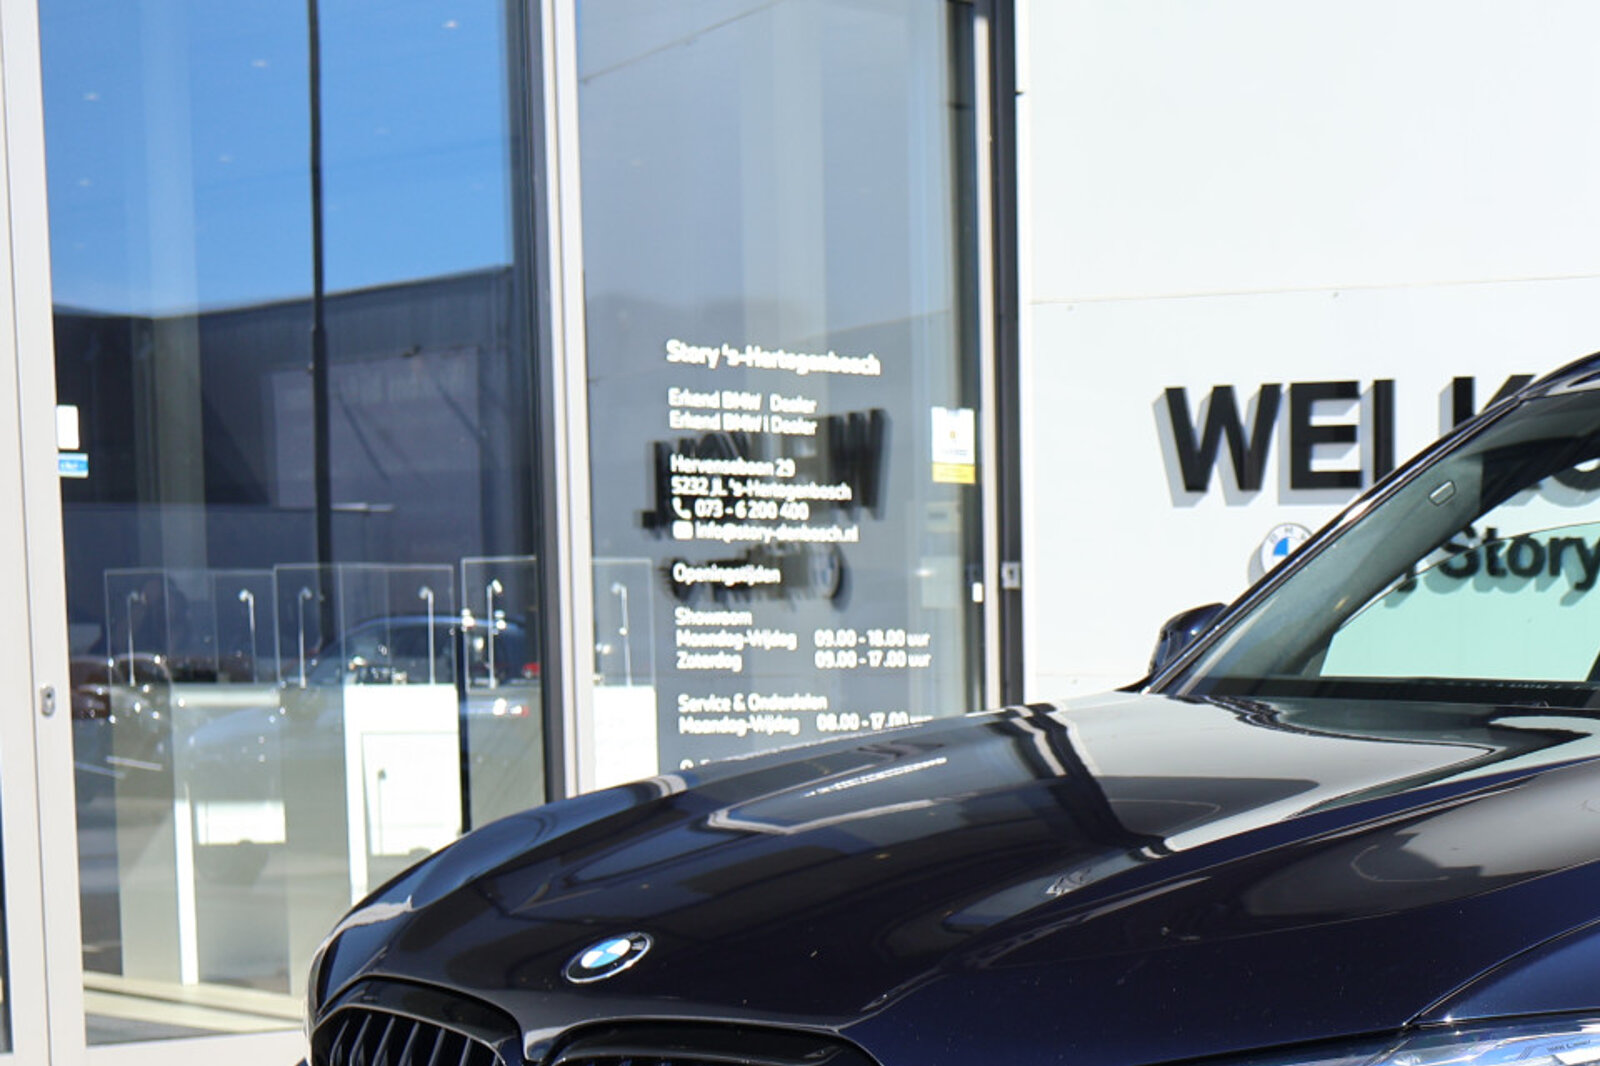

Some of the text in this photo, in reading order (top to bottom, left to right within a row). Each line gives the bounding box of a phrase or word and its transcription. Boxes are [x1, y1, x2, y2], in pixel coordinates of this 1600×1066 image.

[666, 339, 720, 369] Story
[672, 476, 708, 495] 5232
[695, 499, 723, 518] 073
